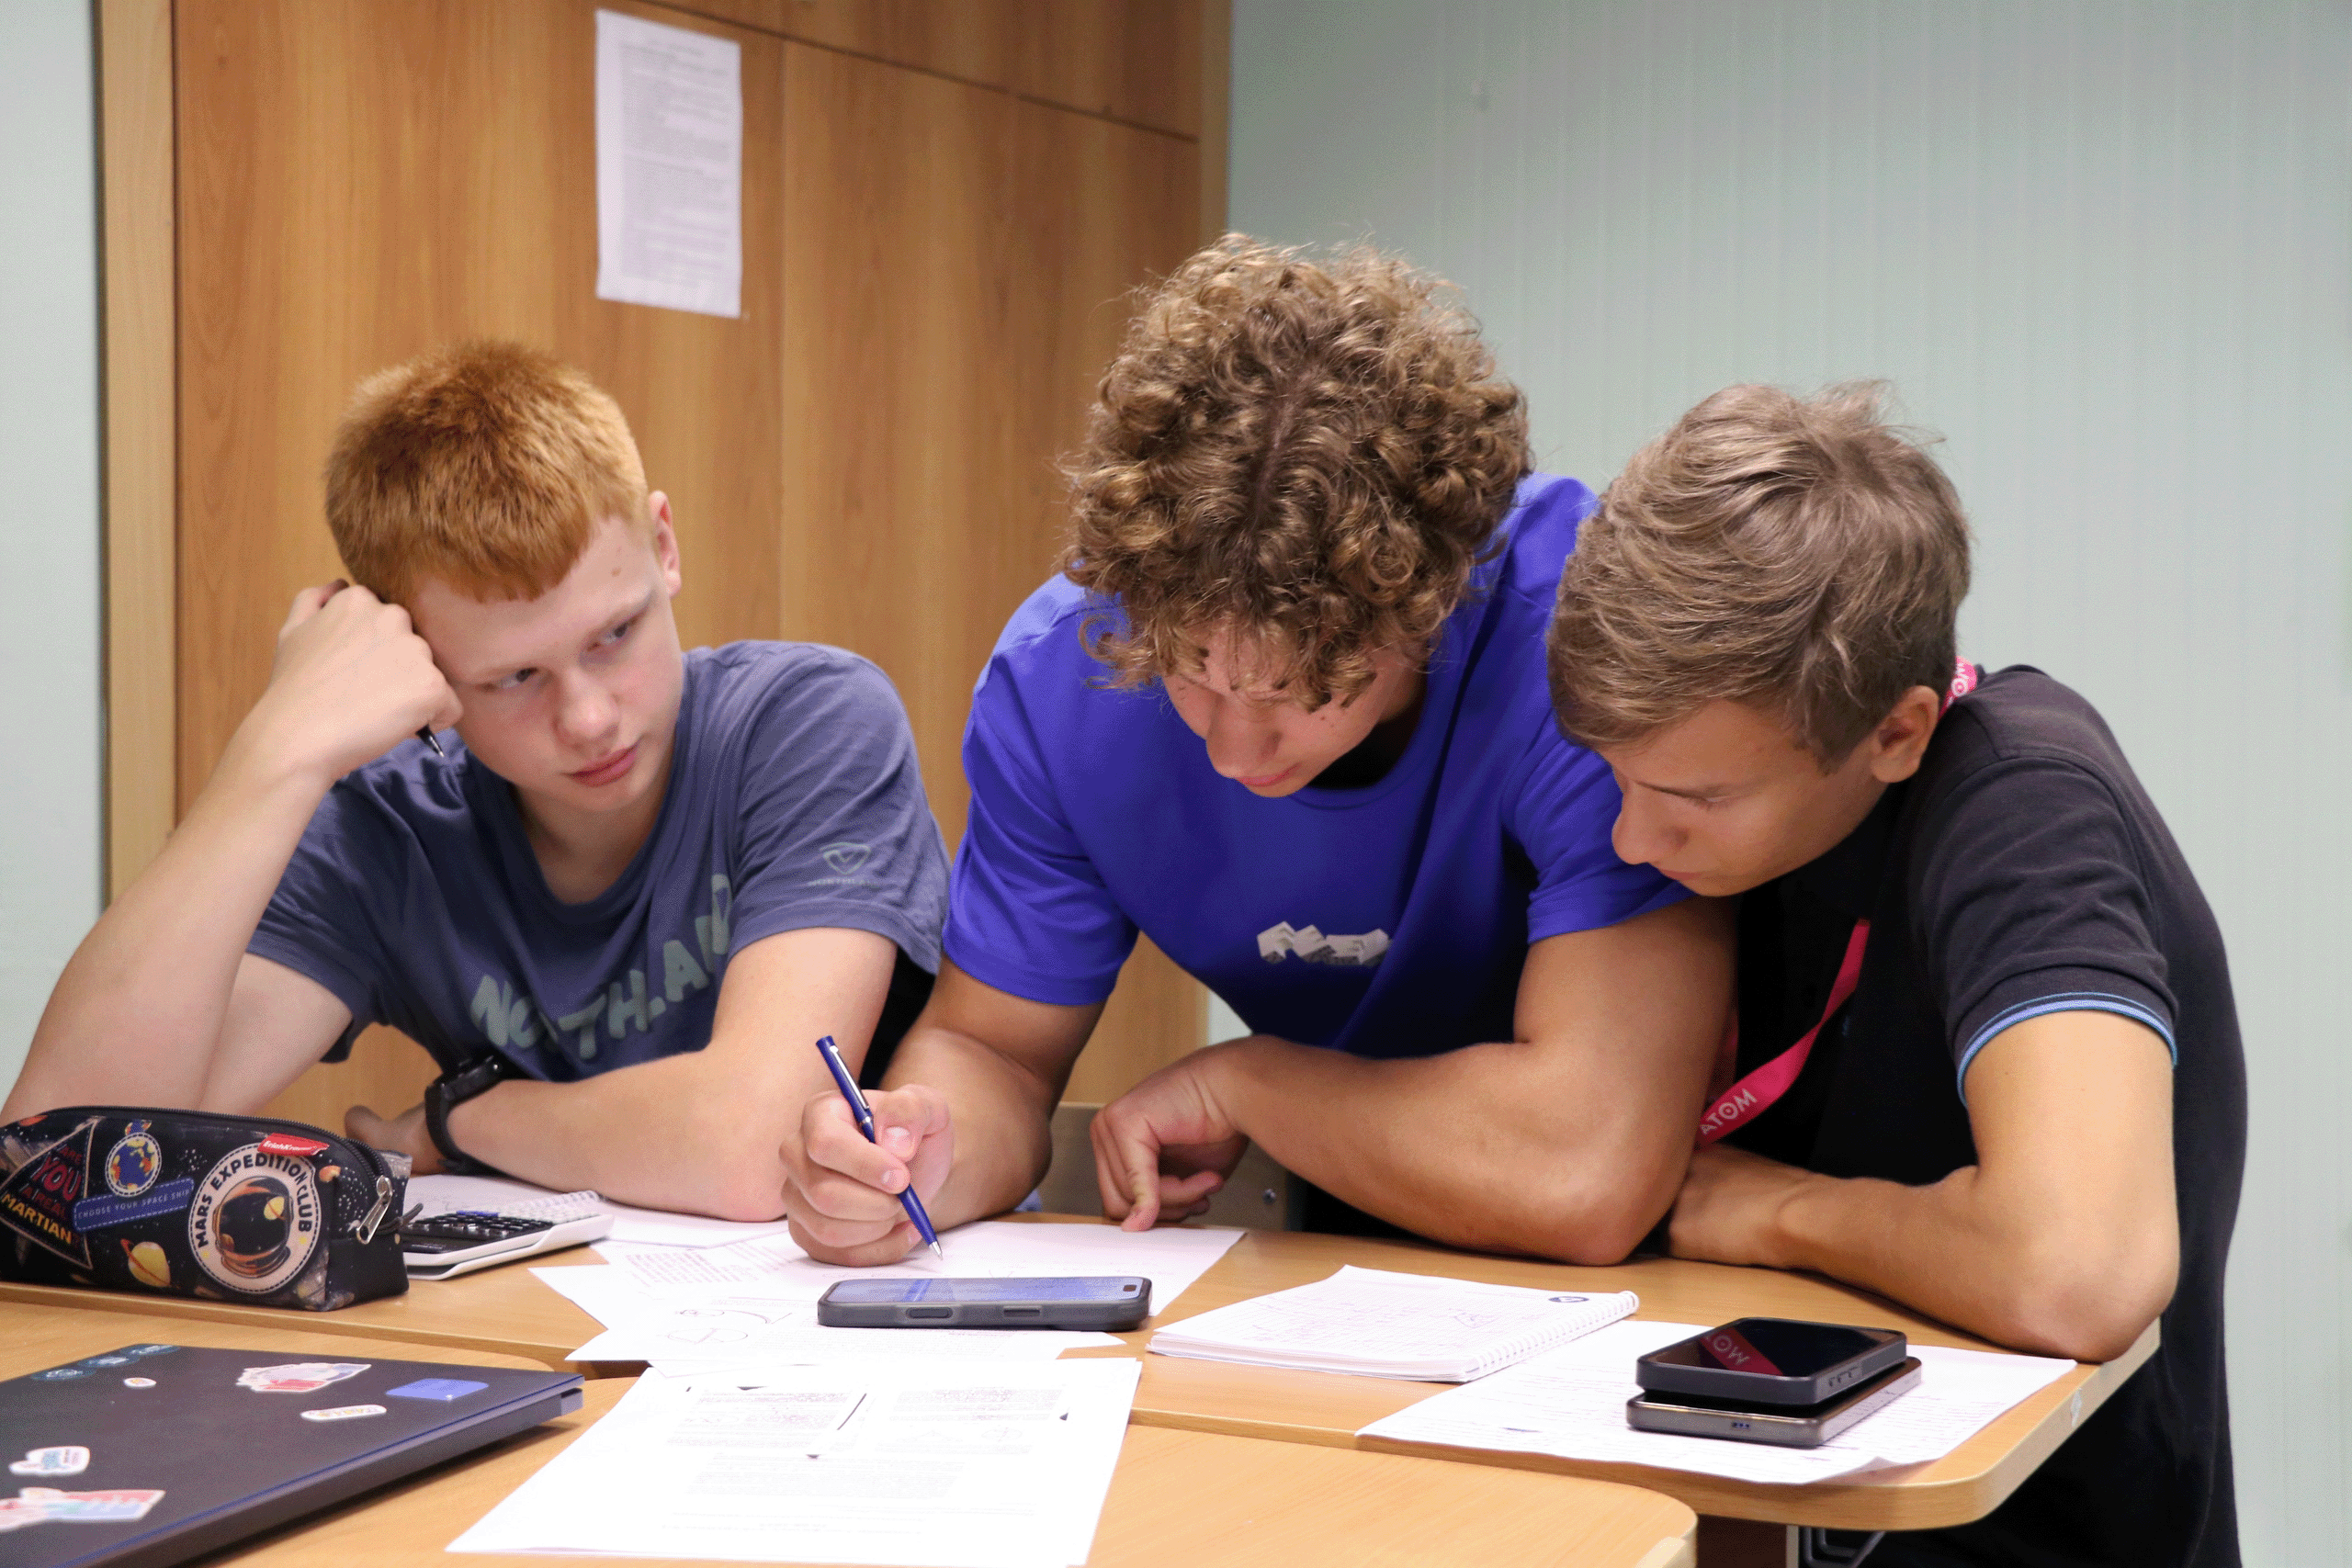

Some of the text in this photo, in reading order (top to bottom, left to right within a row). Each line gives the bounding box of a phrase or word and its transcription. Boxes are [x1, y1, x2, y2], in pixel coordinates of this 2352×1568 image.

[1700, 1088, 1758, 1134] ATOM
[60, 1146, 83, 1165] ARE
[32, 1156, 82, 1201] YOU
[195, 1152, 312, 1248] MARS EXPEDITION CLUB
[115, 1201, 138, 1212] YOUR
[141, 1193, 167, 1207] SPACE
